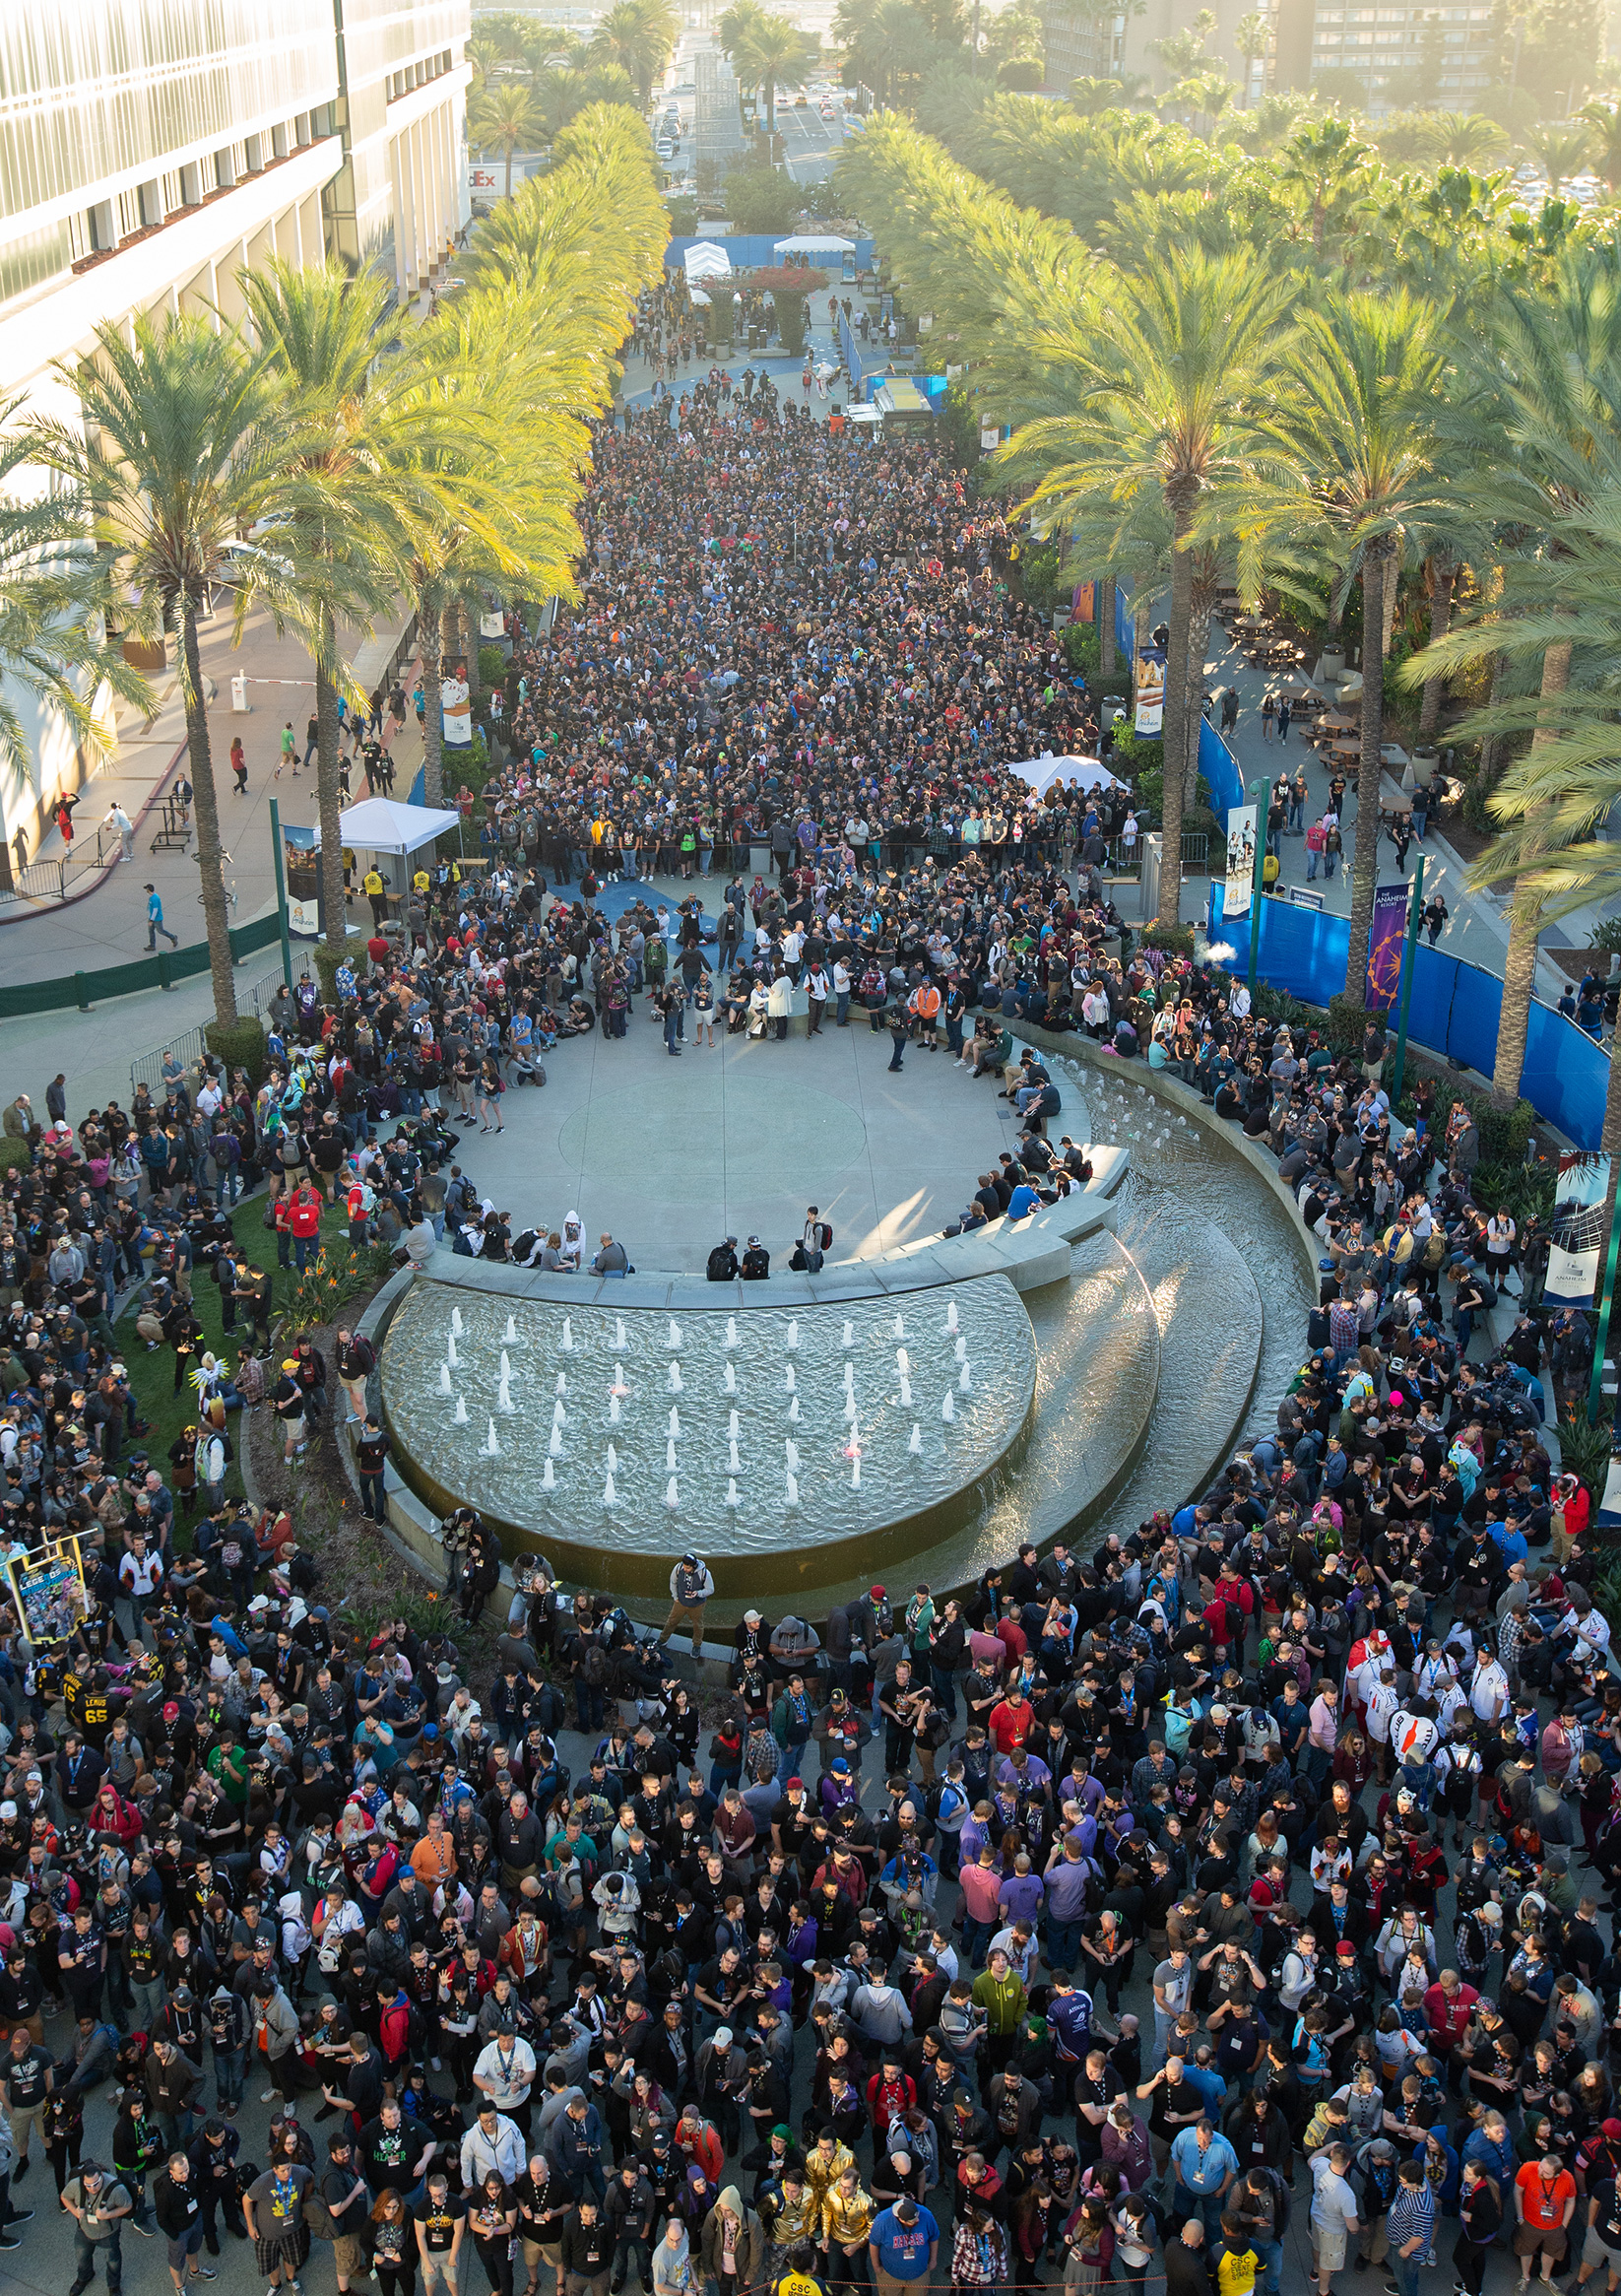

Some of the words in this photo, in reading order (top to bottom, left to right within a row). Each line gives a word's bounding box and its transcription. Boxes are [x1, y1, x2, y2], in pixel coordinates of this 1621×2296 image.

[469, 171, 495, 187] dEx
[1376, 894, 1408, 904] ANAHEIM
[63, 1682, 76, 1703] 15
[85, 1698, 107, 1708] LEMUS
[85, 1709, 108, 1725] 65
[892, 2232, 925, 2249] KANSAS
[1230, 2256, 1251, 2266] CSC
[790, 2281, 811, 2294] CSC
